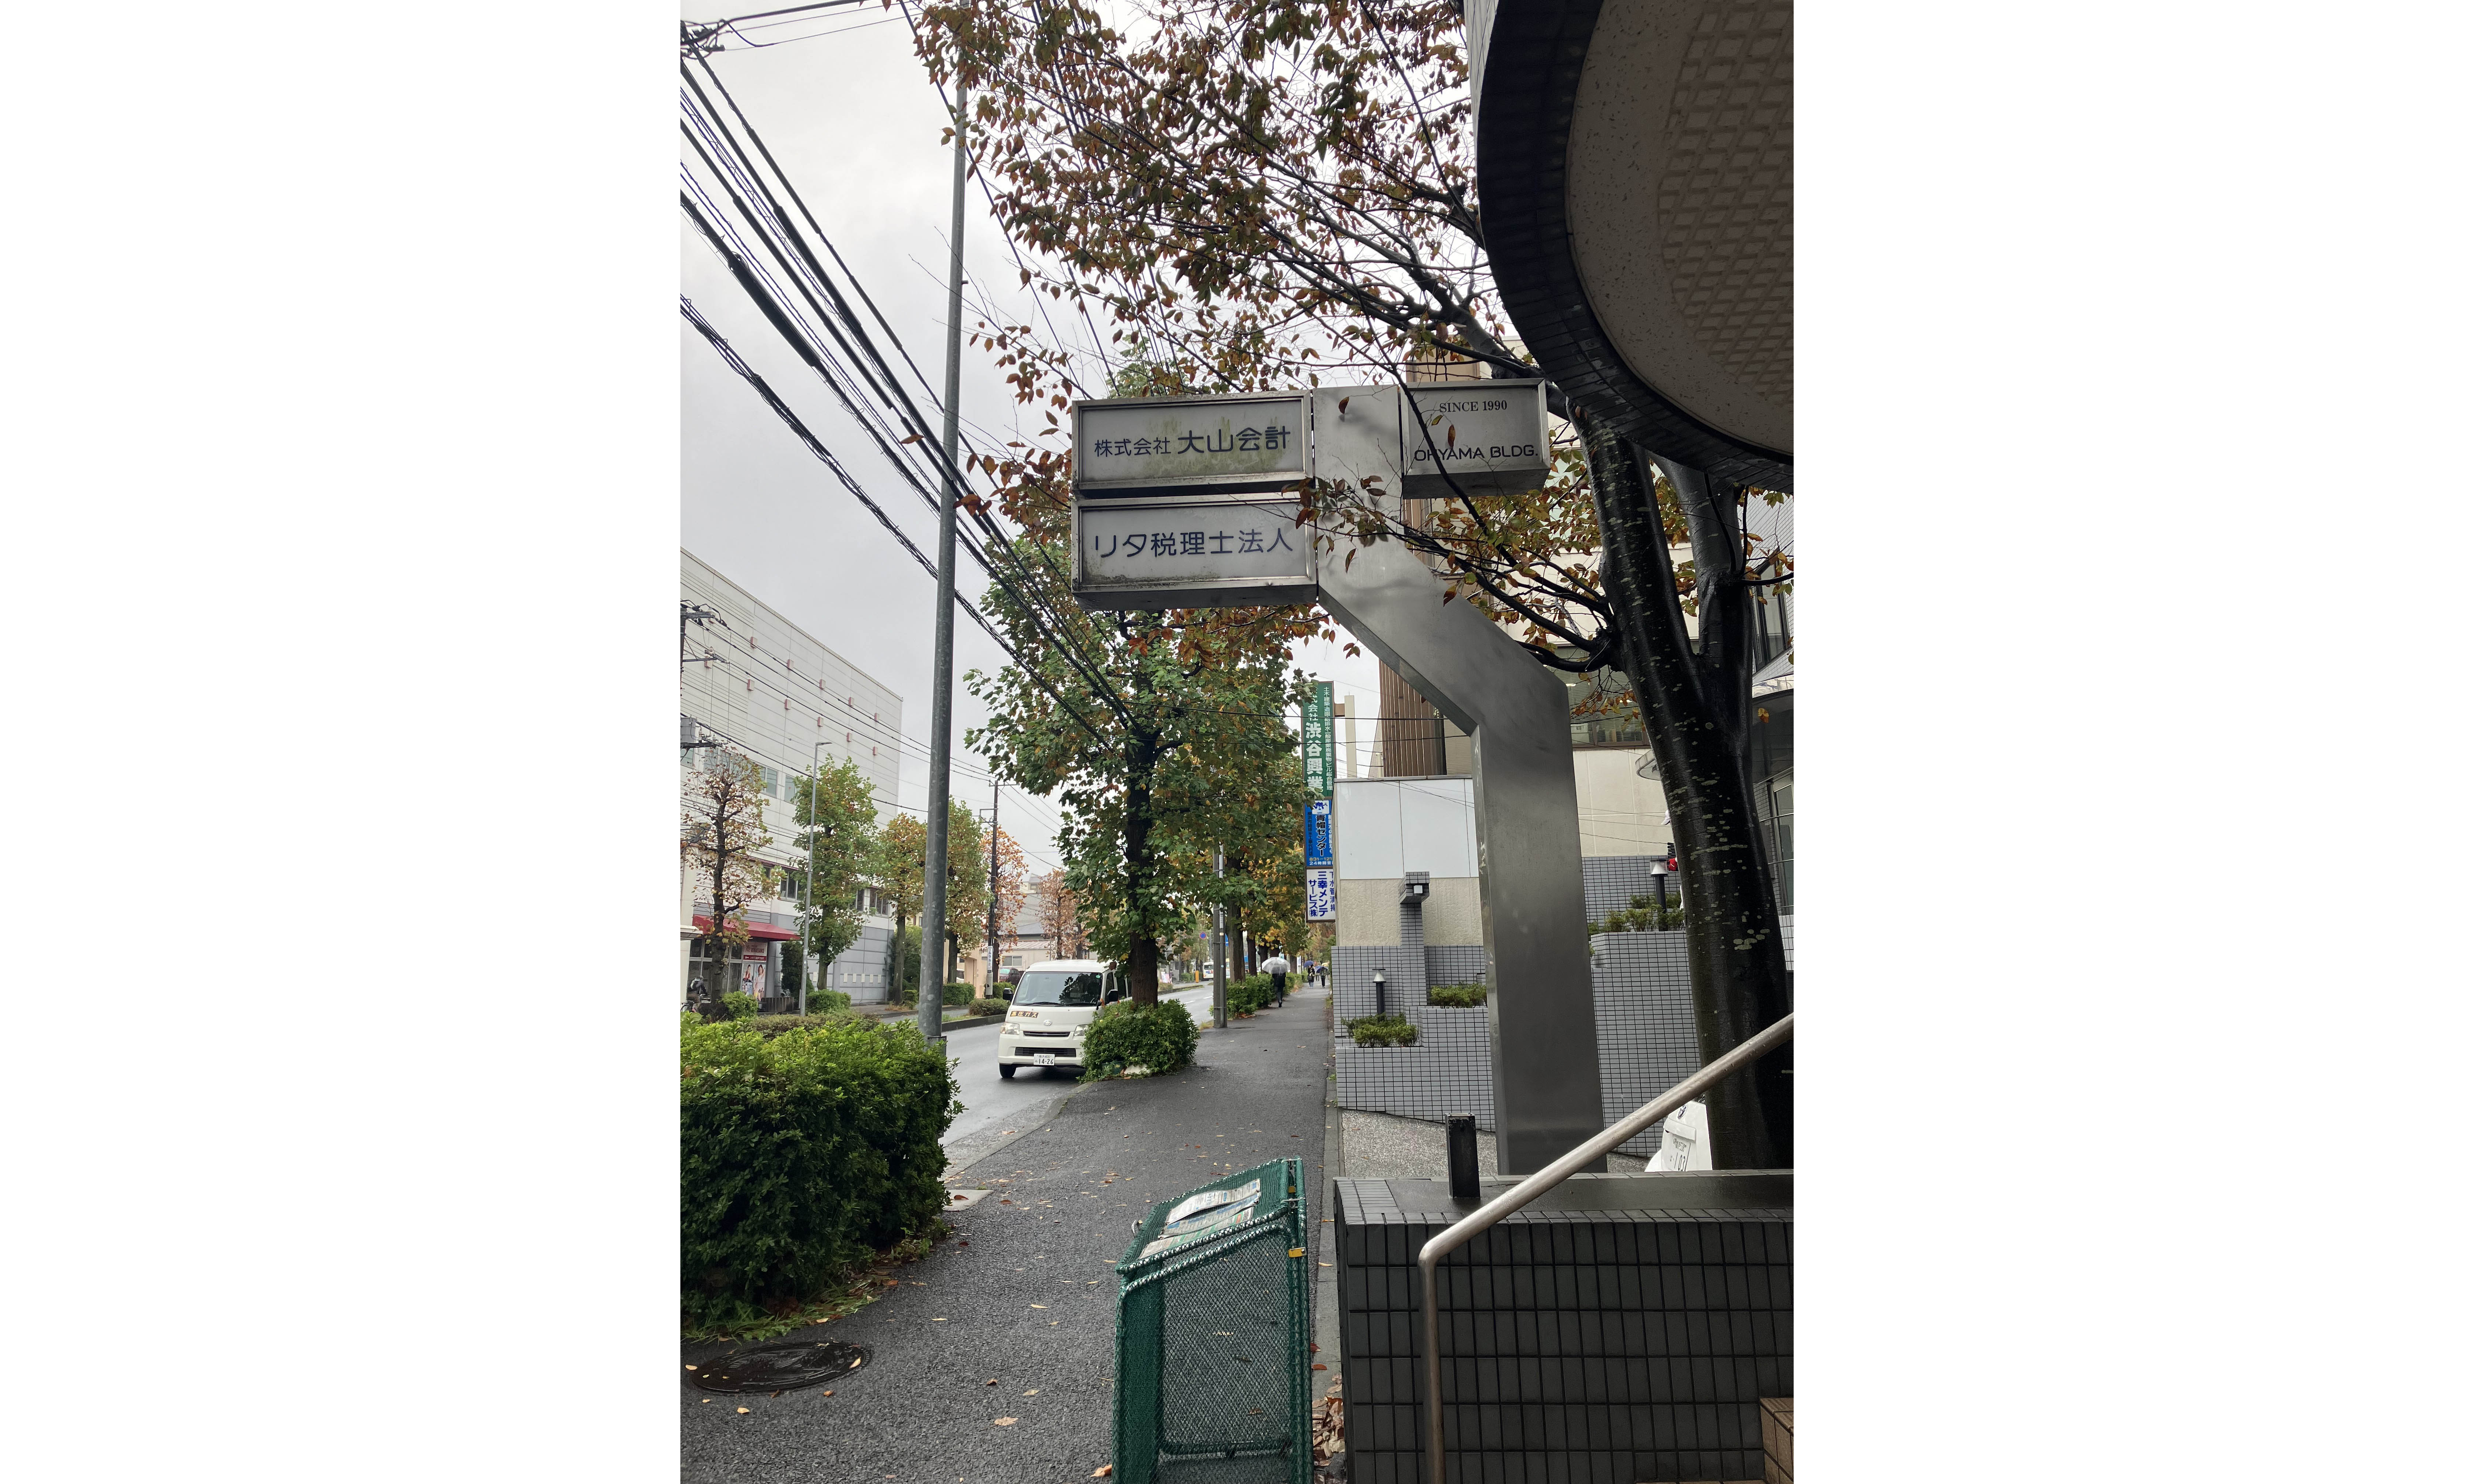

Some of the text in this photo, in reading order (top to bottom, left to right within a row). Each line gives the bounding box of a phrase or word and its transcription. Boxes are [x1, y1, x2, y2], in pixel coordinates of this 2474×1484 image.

[1439, 400, 1507, 413] SINCE 1990
[1491, 444, 1538, 457] BLDG.
[1095, 527, 1293, 558] リタ税理士法人
[1318, 871, 1328, 916] 三幸メンテ
